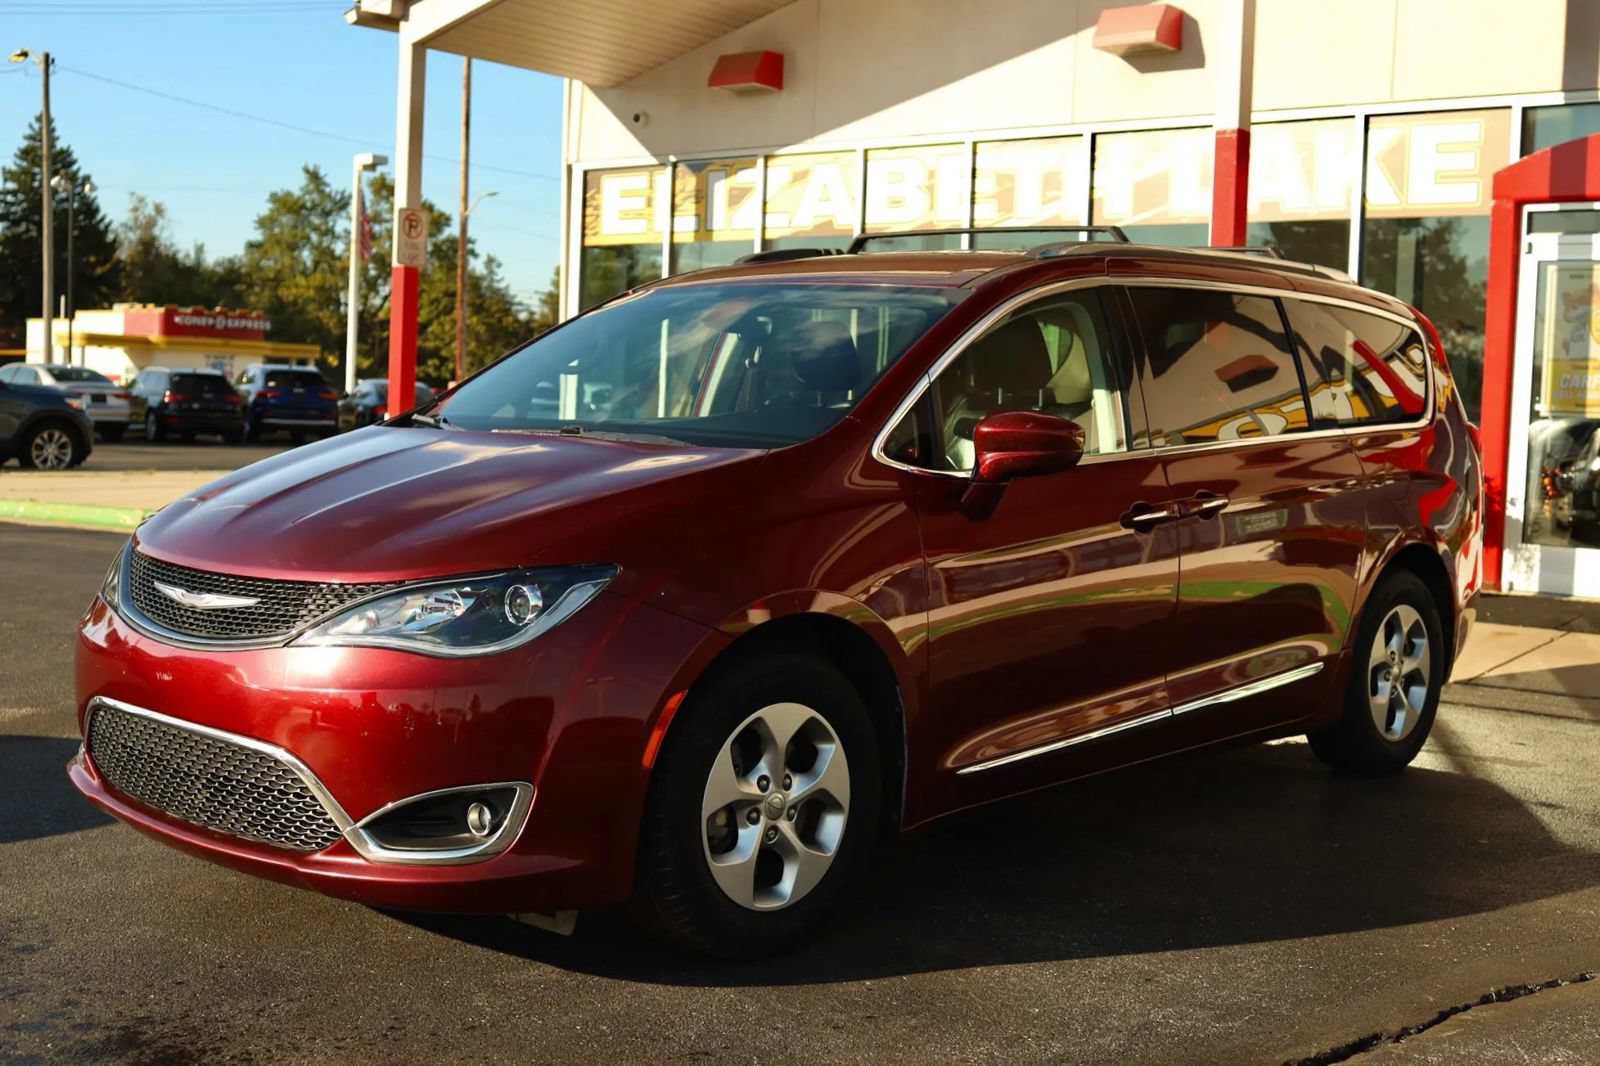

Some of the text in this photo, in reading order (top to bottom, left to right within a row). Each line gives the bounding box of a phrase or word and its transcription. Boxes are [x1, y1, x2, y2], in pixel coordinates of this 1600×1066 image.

[600, 120, 1482, 235] ELIZABETH LAKE
[226, 318, 272, 331] EXPRESS
